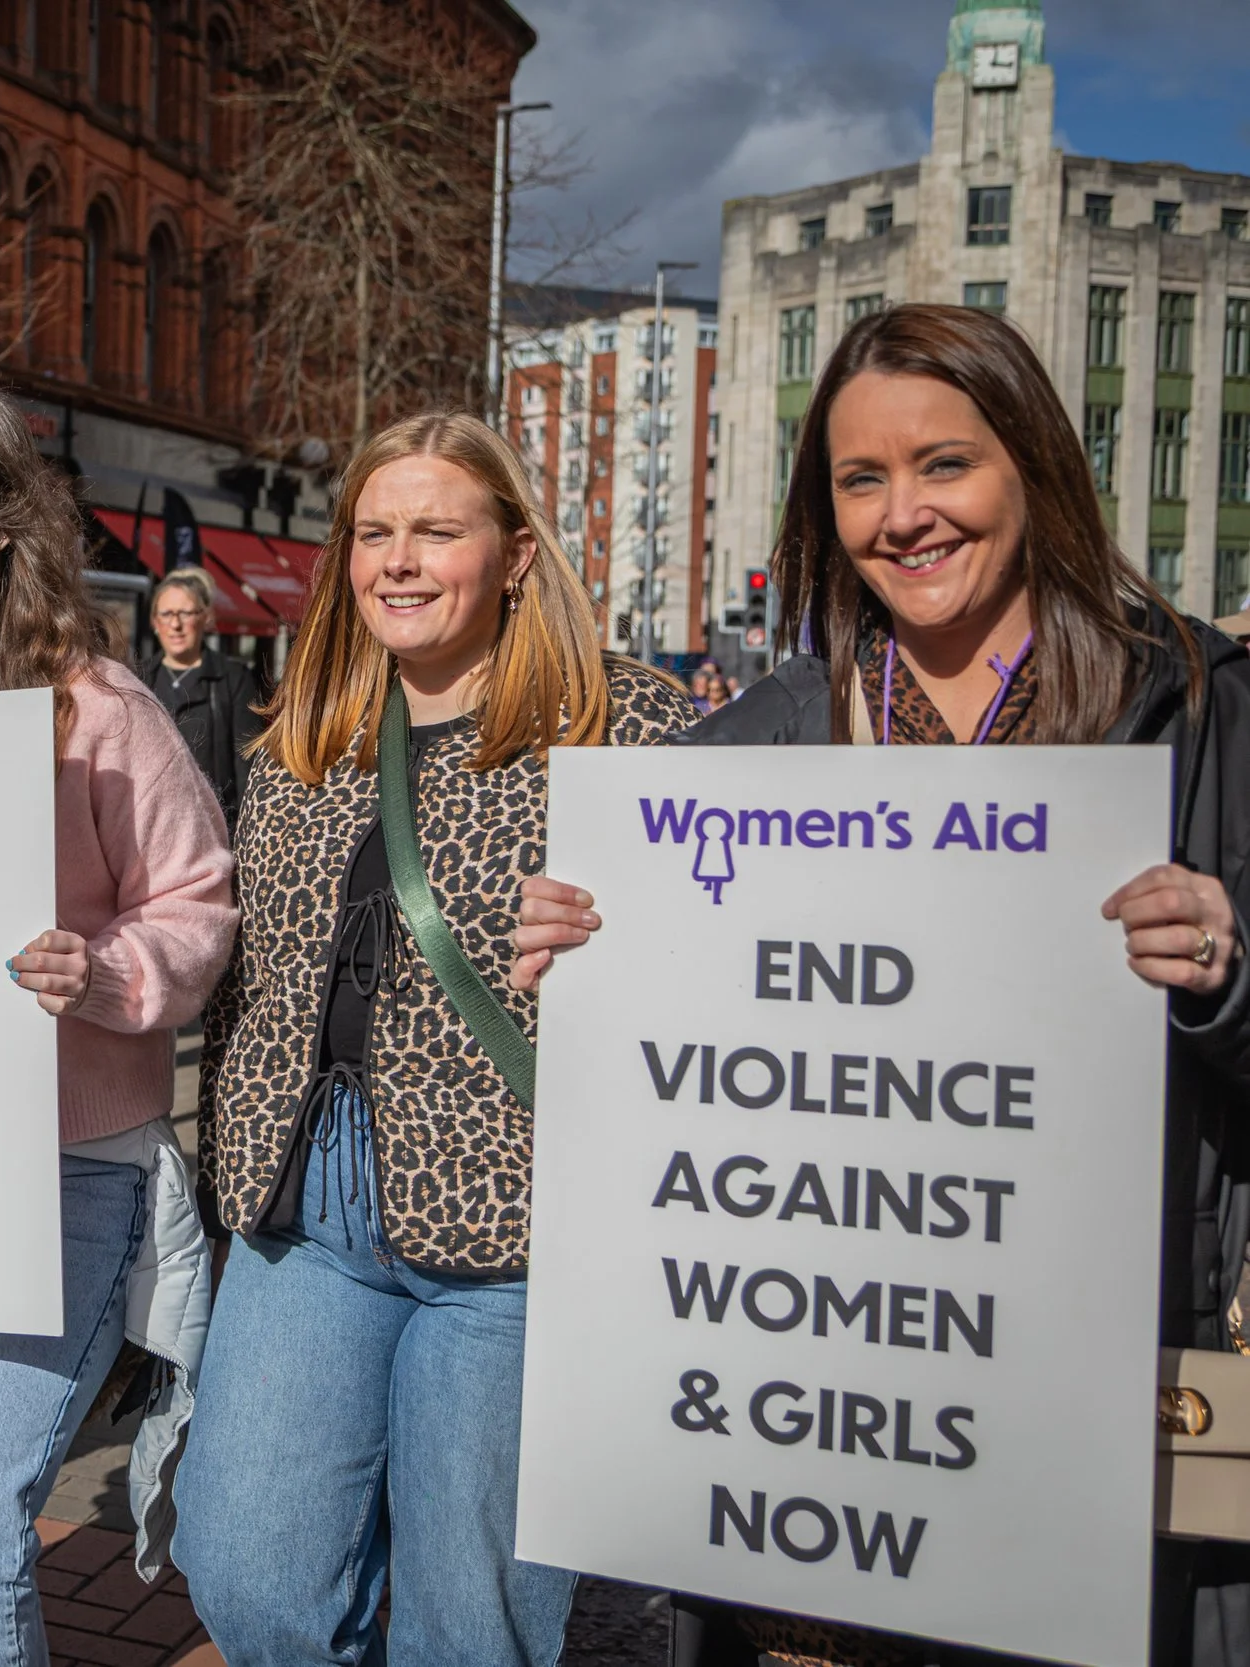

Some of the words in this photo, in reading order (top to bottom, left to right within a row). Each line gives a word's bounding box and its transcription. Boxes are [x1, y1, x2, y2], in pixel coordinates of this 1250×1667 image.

[639, 798, 912, 905] Women's
[933, 802, 1048, 853] Aid
[755, 940, 914, 1006] END
[640, 1040, 1035, 1130] VIOLENCE
[651, 1150, 1015, 1243] AGAINST
[661, 1257, 995, 1359] WOMEN
[671, 1369, 732, 1436] &
[748, 1380, 977, 1471] GIRLS
[709, 1483, 928, 1579] NOW
